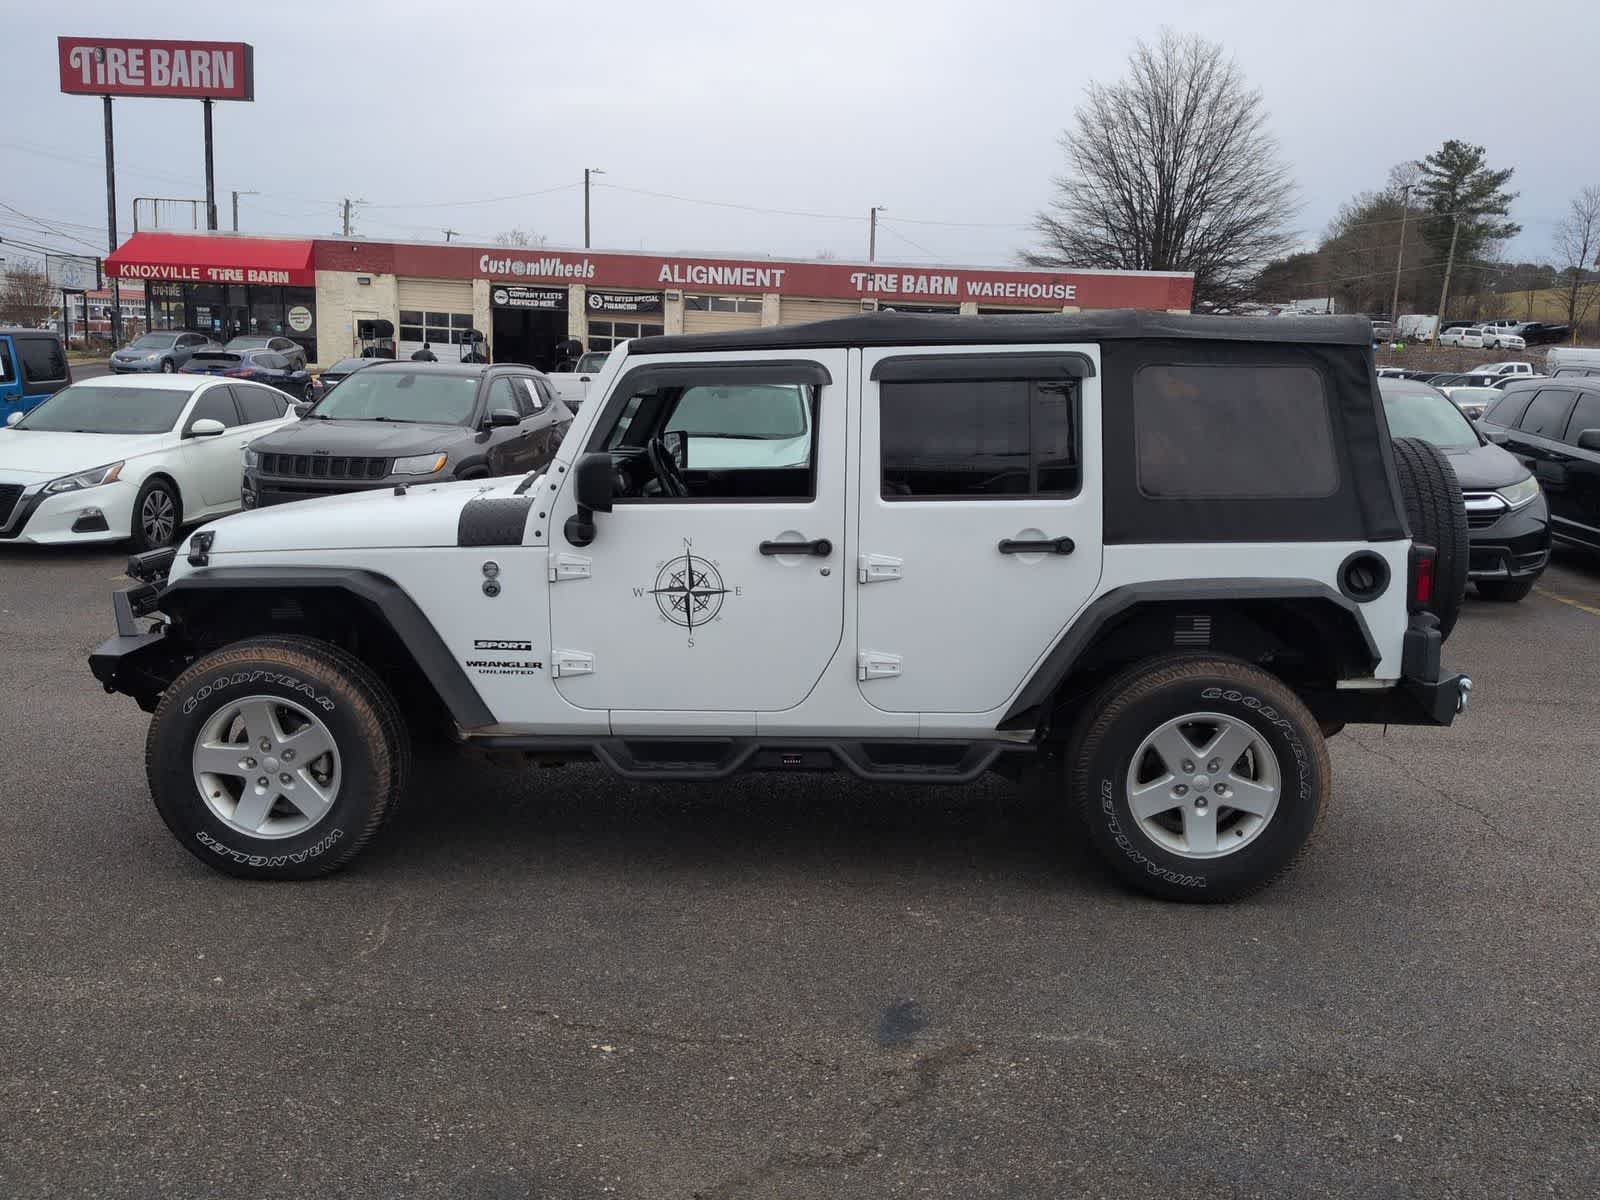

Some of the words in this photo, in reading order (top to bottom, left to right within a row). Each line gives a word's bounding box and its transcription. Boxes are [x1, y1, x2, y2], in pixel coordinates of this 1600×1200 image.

[150, 49, 234, 88] BARN
[119, 264, 200, 279] KNOXVILLE
[248, 270, 289, 283] BARN
[658, 264, 785, 287] ALIGNMENT
[902, 274, 959, 295] BARN
[966, 281, 1077, 299] WAREHOUSE
[509, 290, 539, 299] COMPANY
[540, 292, 564, 300] FLEETS
[634, 294, 660, 303] SPECIAL
[509, 298, 539, 306] SERVICED
[683, 537, 692, 547] N
[632, 587, 644, 597] W
[735, 586, 743, 596] E
[474, 640, 531, 650] SPORT
[687, 638, 695, 648] S
[466, 660, 543, 669] WRANGLER
[183, 671, 336, 714] GOODYEAR
[1201, 686, 1314, 801] GOODYEAR
[1101, 778, 1207, 888] WRANGLER
[195, 828, 344, 867] WRANGLER
